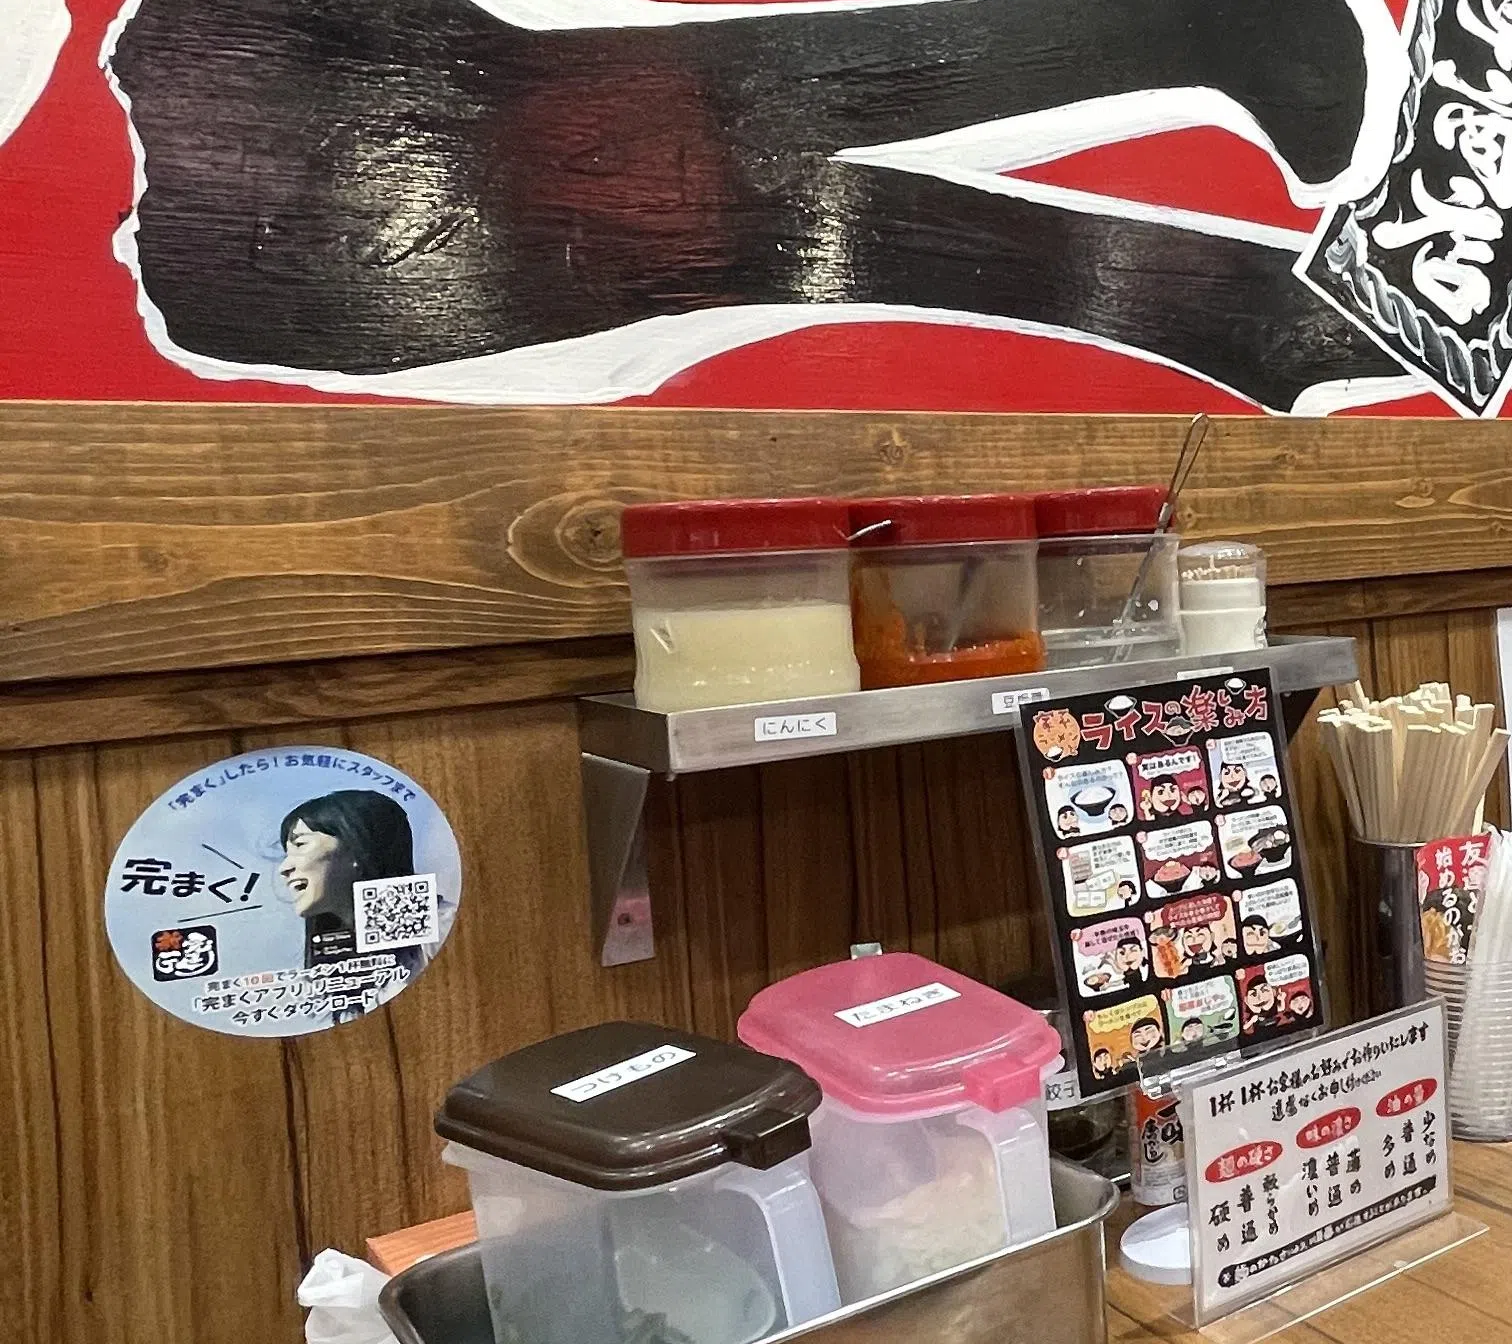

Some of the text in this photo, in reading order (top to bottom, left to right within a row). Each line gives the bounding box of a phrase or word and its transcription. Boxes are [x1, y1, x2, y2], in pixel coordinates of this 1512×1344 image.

[763, 717, 827, 735] にんにく
[120, 857, 261, 903] 完まく!
[852, 988, 944, 1022] たまねぎ
[571, 1051, 676, 1093] つけもの
[1382, 1134, 1396, 1179] 多め
[1400, 1118, 1418, 1176] 普通
[1421, 1110, 1437, 1164] 少なめ
[1301, 1156, 1320, 1216] 濃いめ
[1325, 1151, 1343, 1208] 普通
[1345, 1147, 1362, 1194] 薄め
[1237, 1184, 1259, 1244] 普通
